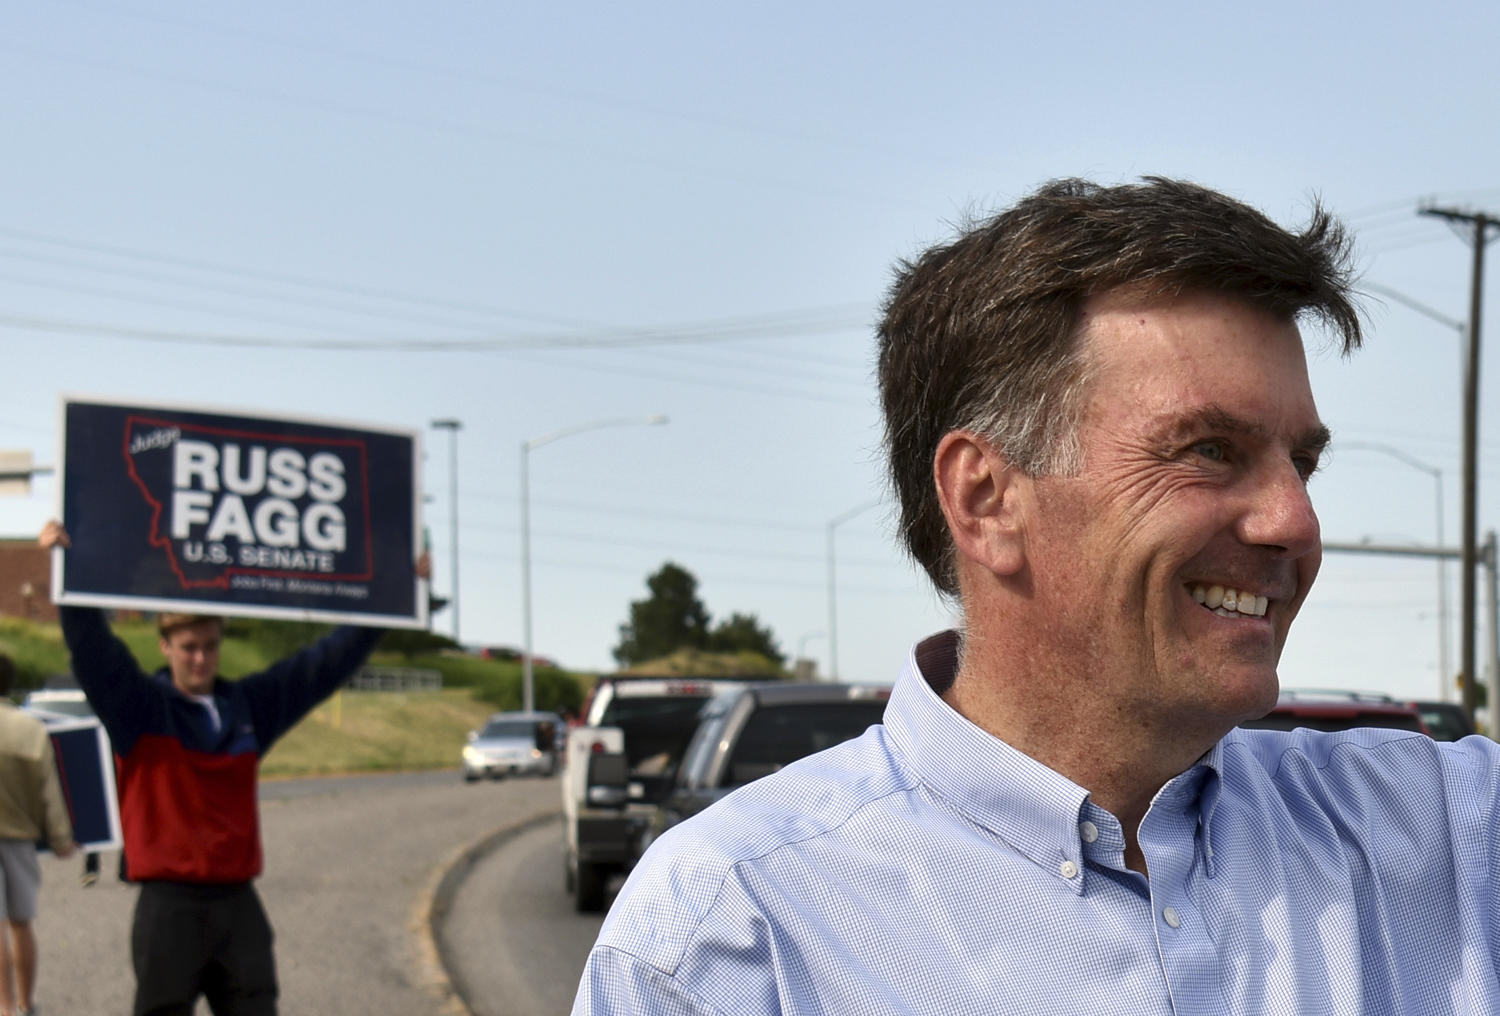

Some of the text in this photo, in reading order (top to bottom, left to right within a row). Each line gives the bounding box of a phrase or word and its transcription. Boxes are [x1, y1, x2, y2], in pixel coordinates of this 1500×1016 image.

[129, 426, 181, 454] Judge
[174, 439, 347, 503] RUSS
[172, 490, 347, 552] FAGG
[183, 541, 335, 573] U.S. SENATE
